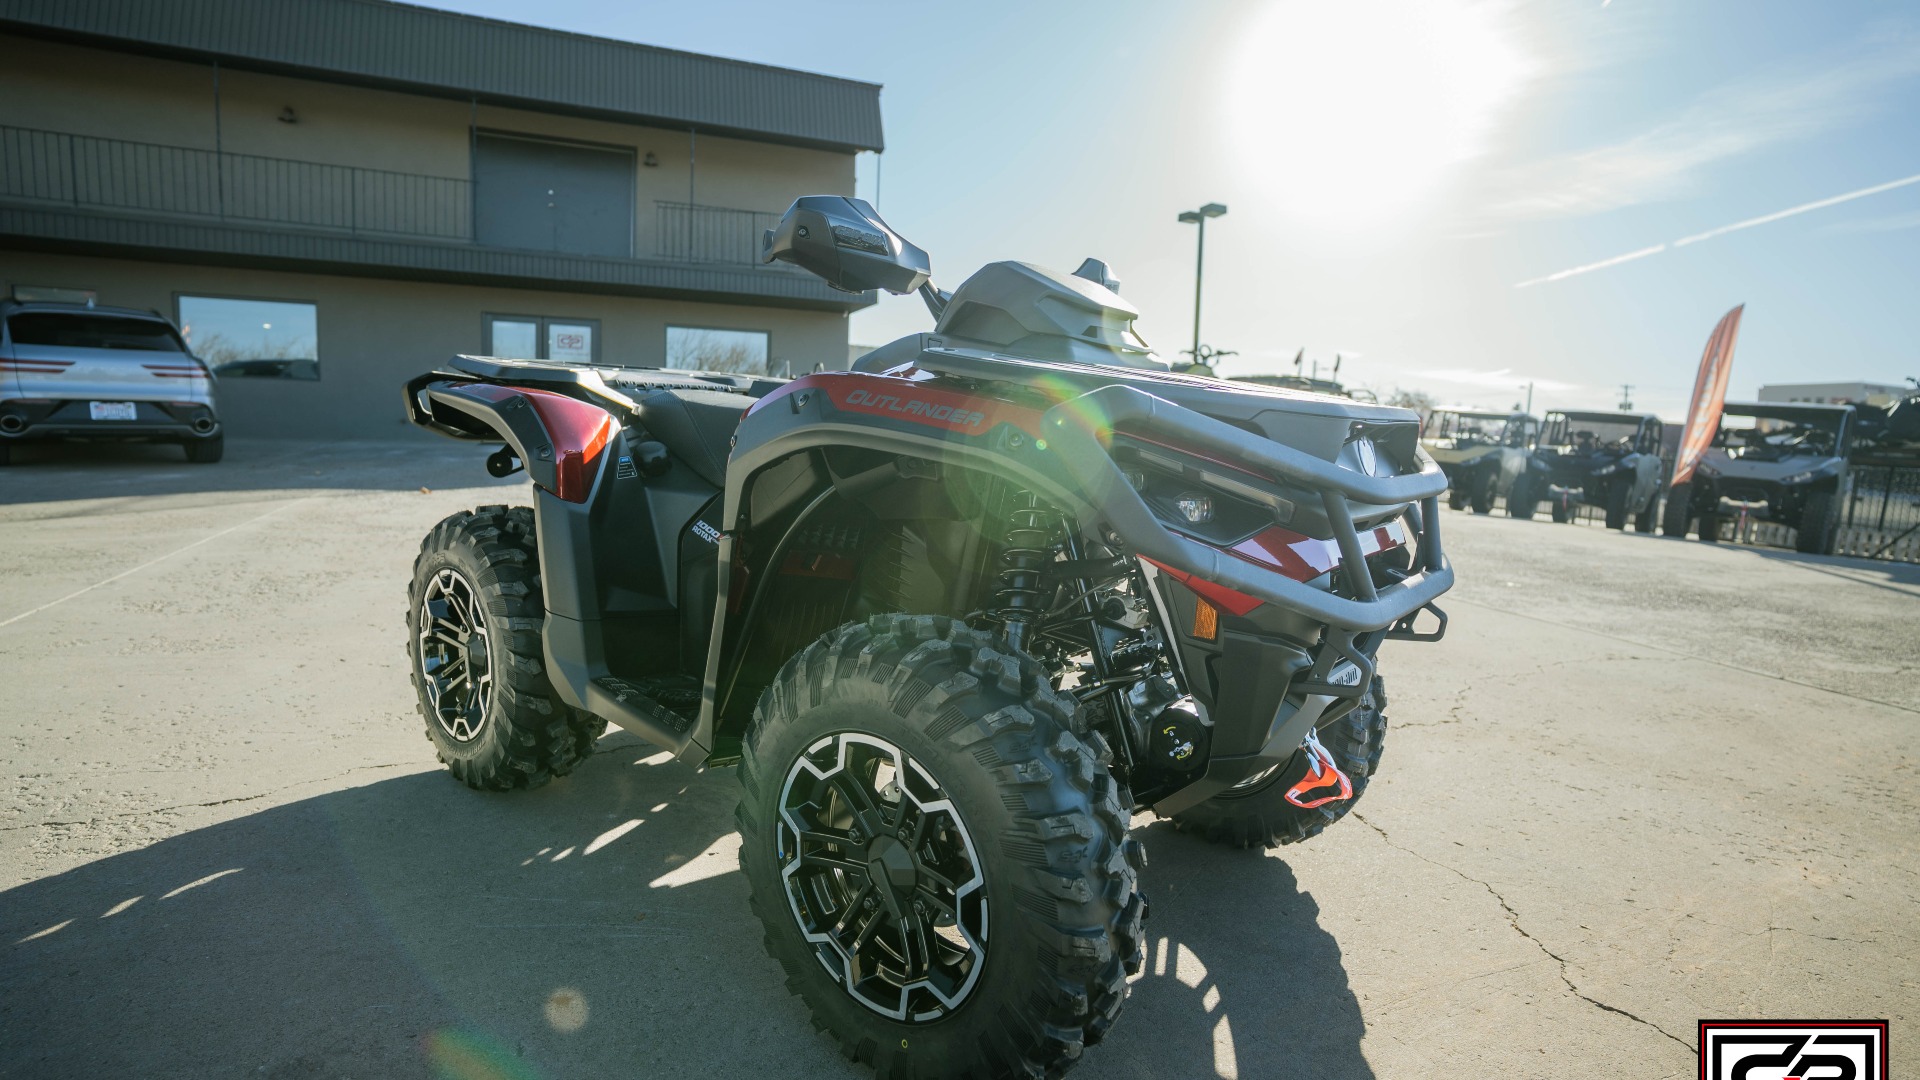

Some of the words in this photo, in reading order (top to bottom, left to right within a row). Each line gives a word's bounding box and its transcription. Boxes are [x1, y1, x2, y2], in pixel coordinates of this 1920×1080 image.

[846, 390, 984, 427] OUTLANDER
[691, 525, 712, 543] ROTAX
[696, 520, 724, 539] 1000
